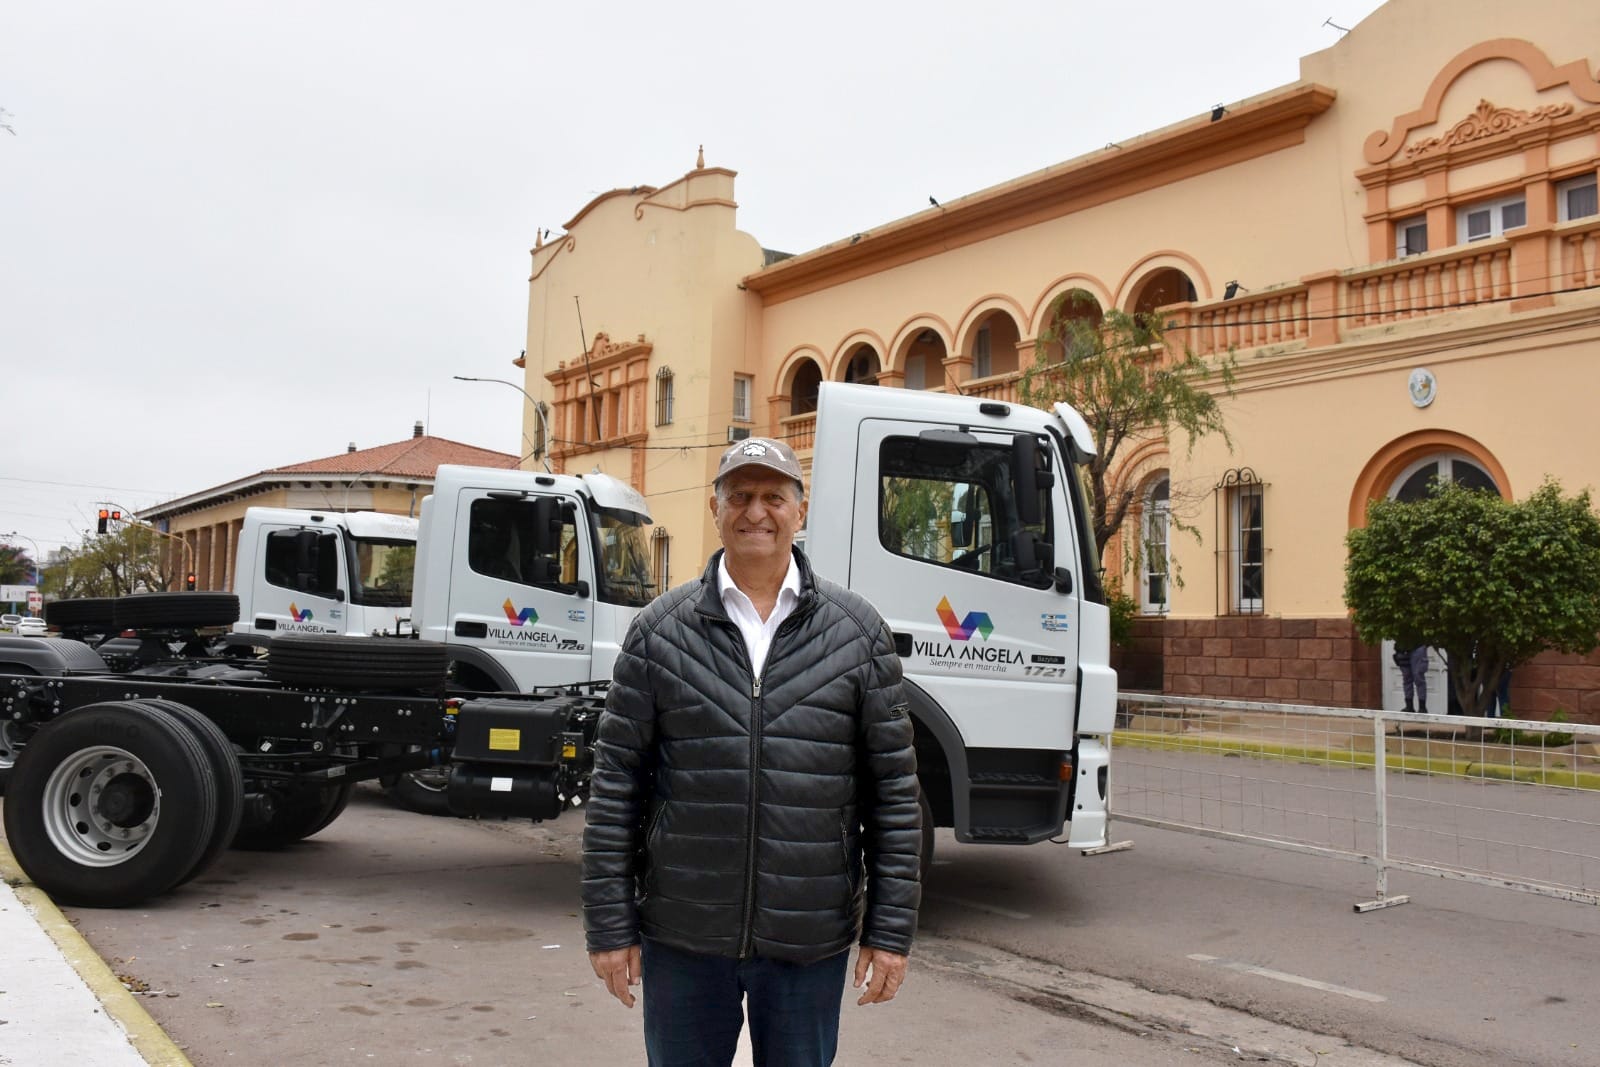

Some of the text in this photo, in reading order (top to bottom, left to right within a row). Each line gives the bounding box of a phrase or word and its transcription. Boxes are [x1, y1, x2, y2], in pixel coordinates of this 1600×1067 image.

[278, 623, 324, 633] VILLA ANGELA
[488, 628, 513, 640] VILLA
[516, 631, 558, 643] ANGELA
[556, 643, 585, 651] 1726
[914, 641, 1024, 664] VILLA ANGELA
[929, 658, 1007, 673] Siempre en marcha
[1024, 666, 1066, 678] 1721
